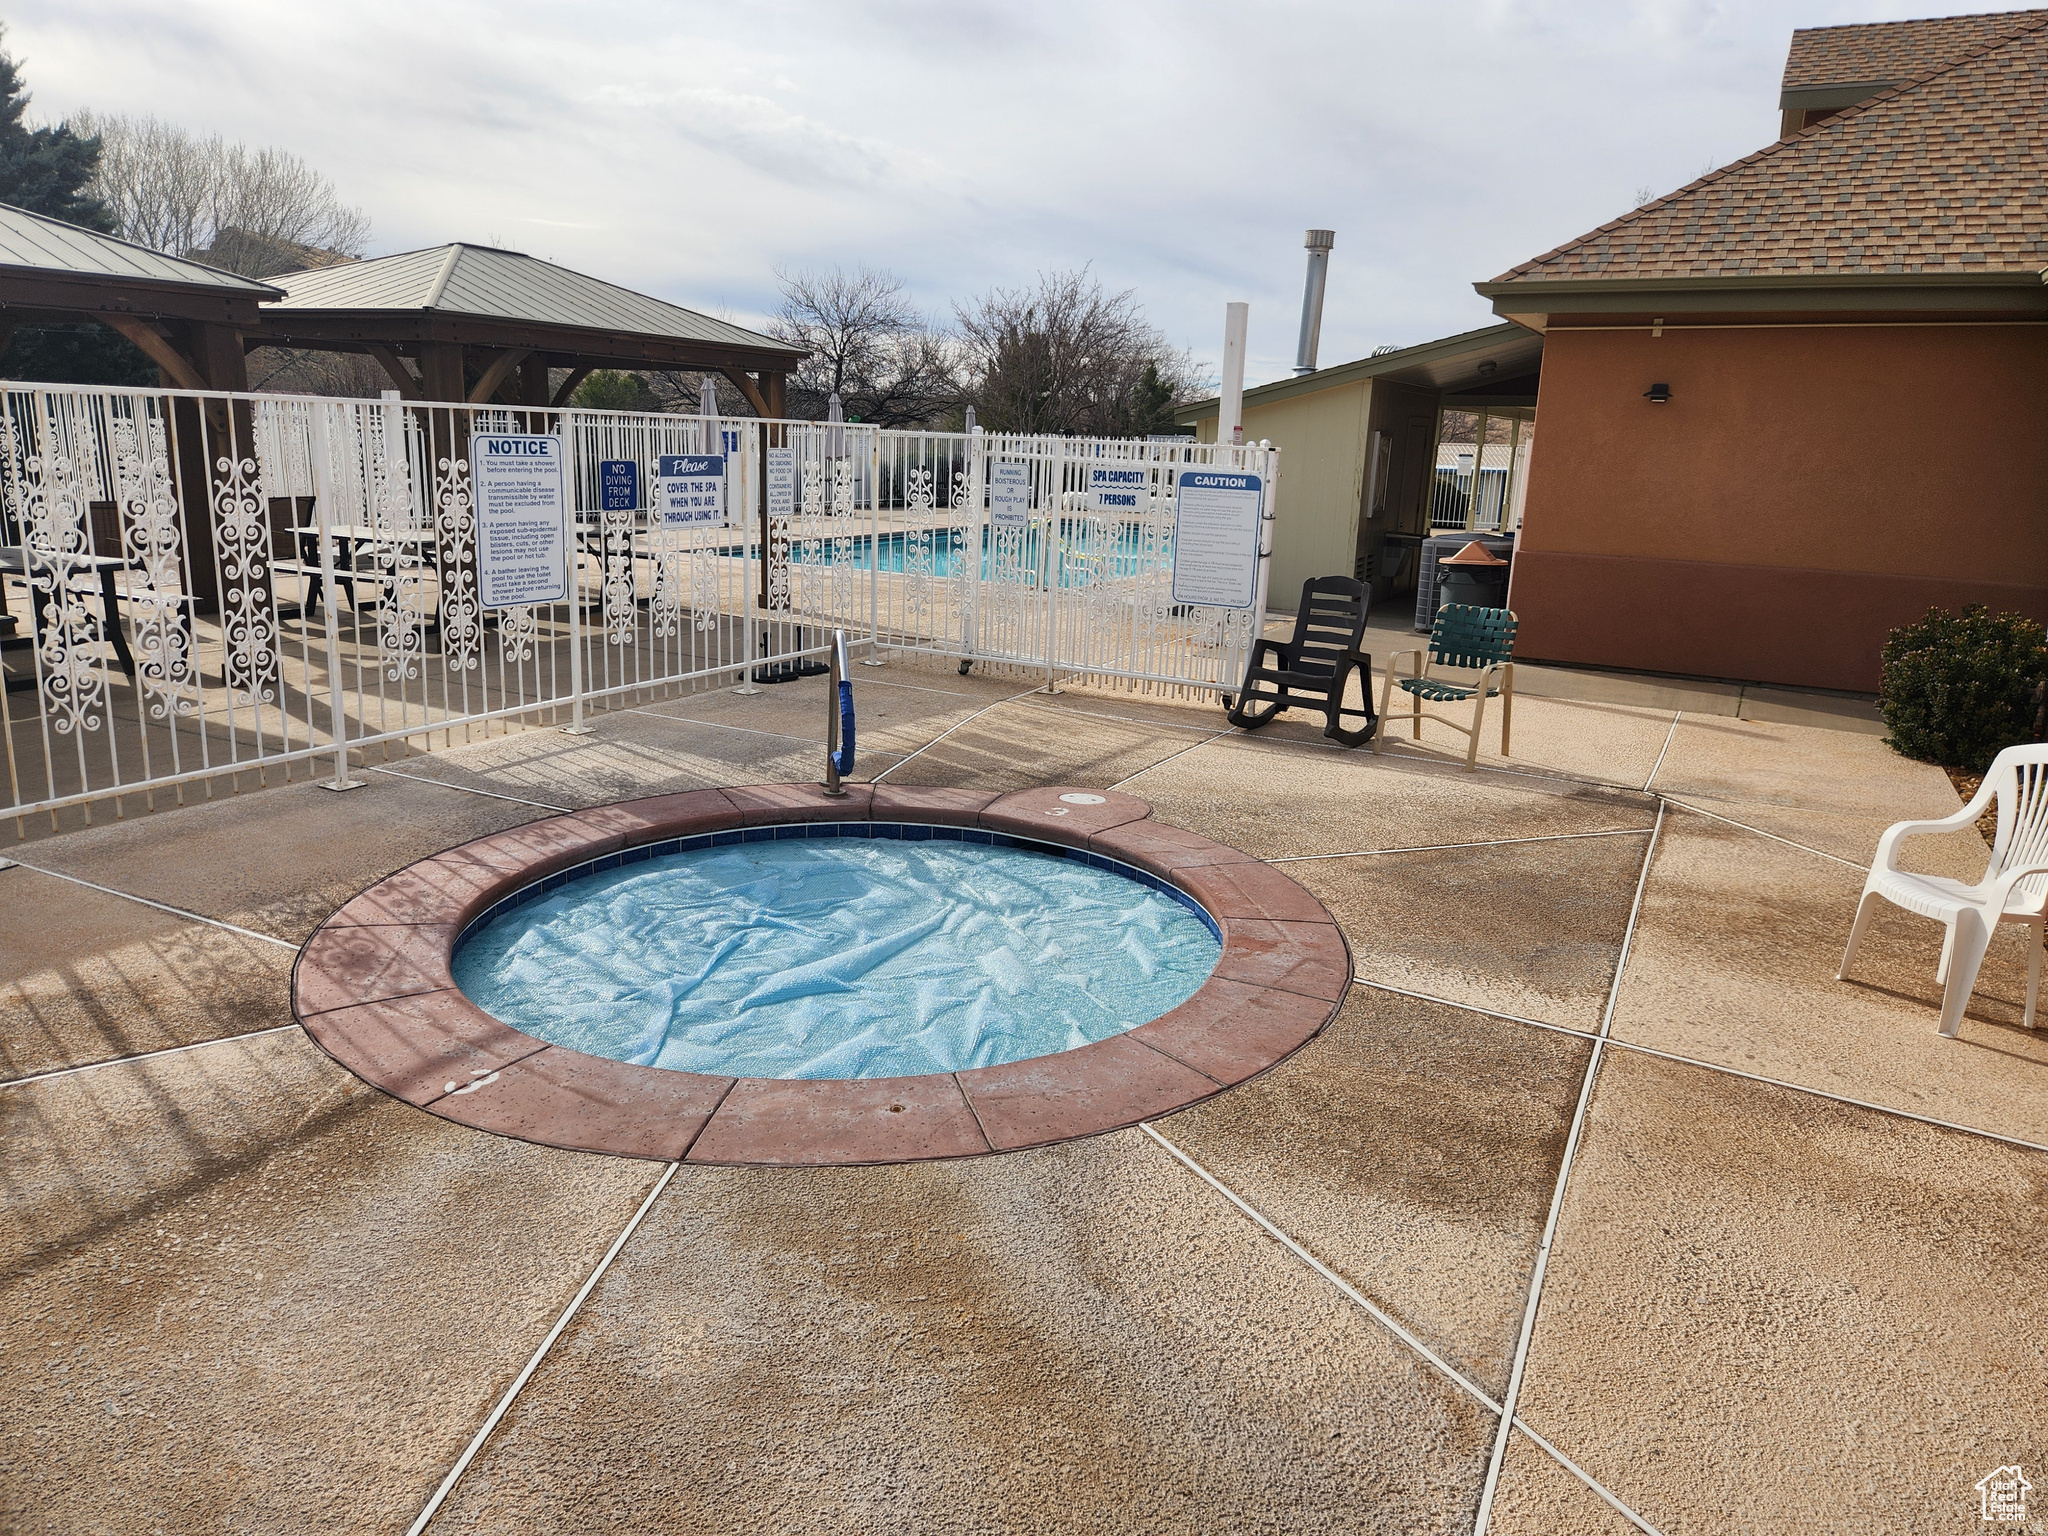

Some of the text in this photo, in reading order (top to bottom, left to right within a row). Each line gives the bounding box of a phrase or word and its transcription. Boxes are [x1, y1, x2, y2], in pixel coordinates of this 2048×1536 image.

[488, 440, 548, 455] NOTICE
[612, 464, 625, 474] NO
[672, 458, 709, 475] Please
[605, 475, 632, 485] DIVING
[1093, 470, 1144, 483] SPA CAPACITY
[1195, 476, 1246, 487] CAUTION
[608, 486, 630, 496] FROM
[667, 482, 717, 493] COVER THE SPA
[608, 497, 630, 508] DECK
[670, 496, 715, 508] WHEN YOU ARE
[995, 495, 1012, 503] ROUGH
[1099, 493, 1136, 506] 7 PERSONS
[664, 511, 692, 523] THROUGH
[695, 510, 711, 521] USING
[1044, 807, 1069, 817] 3
